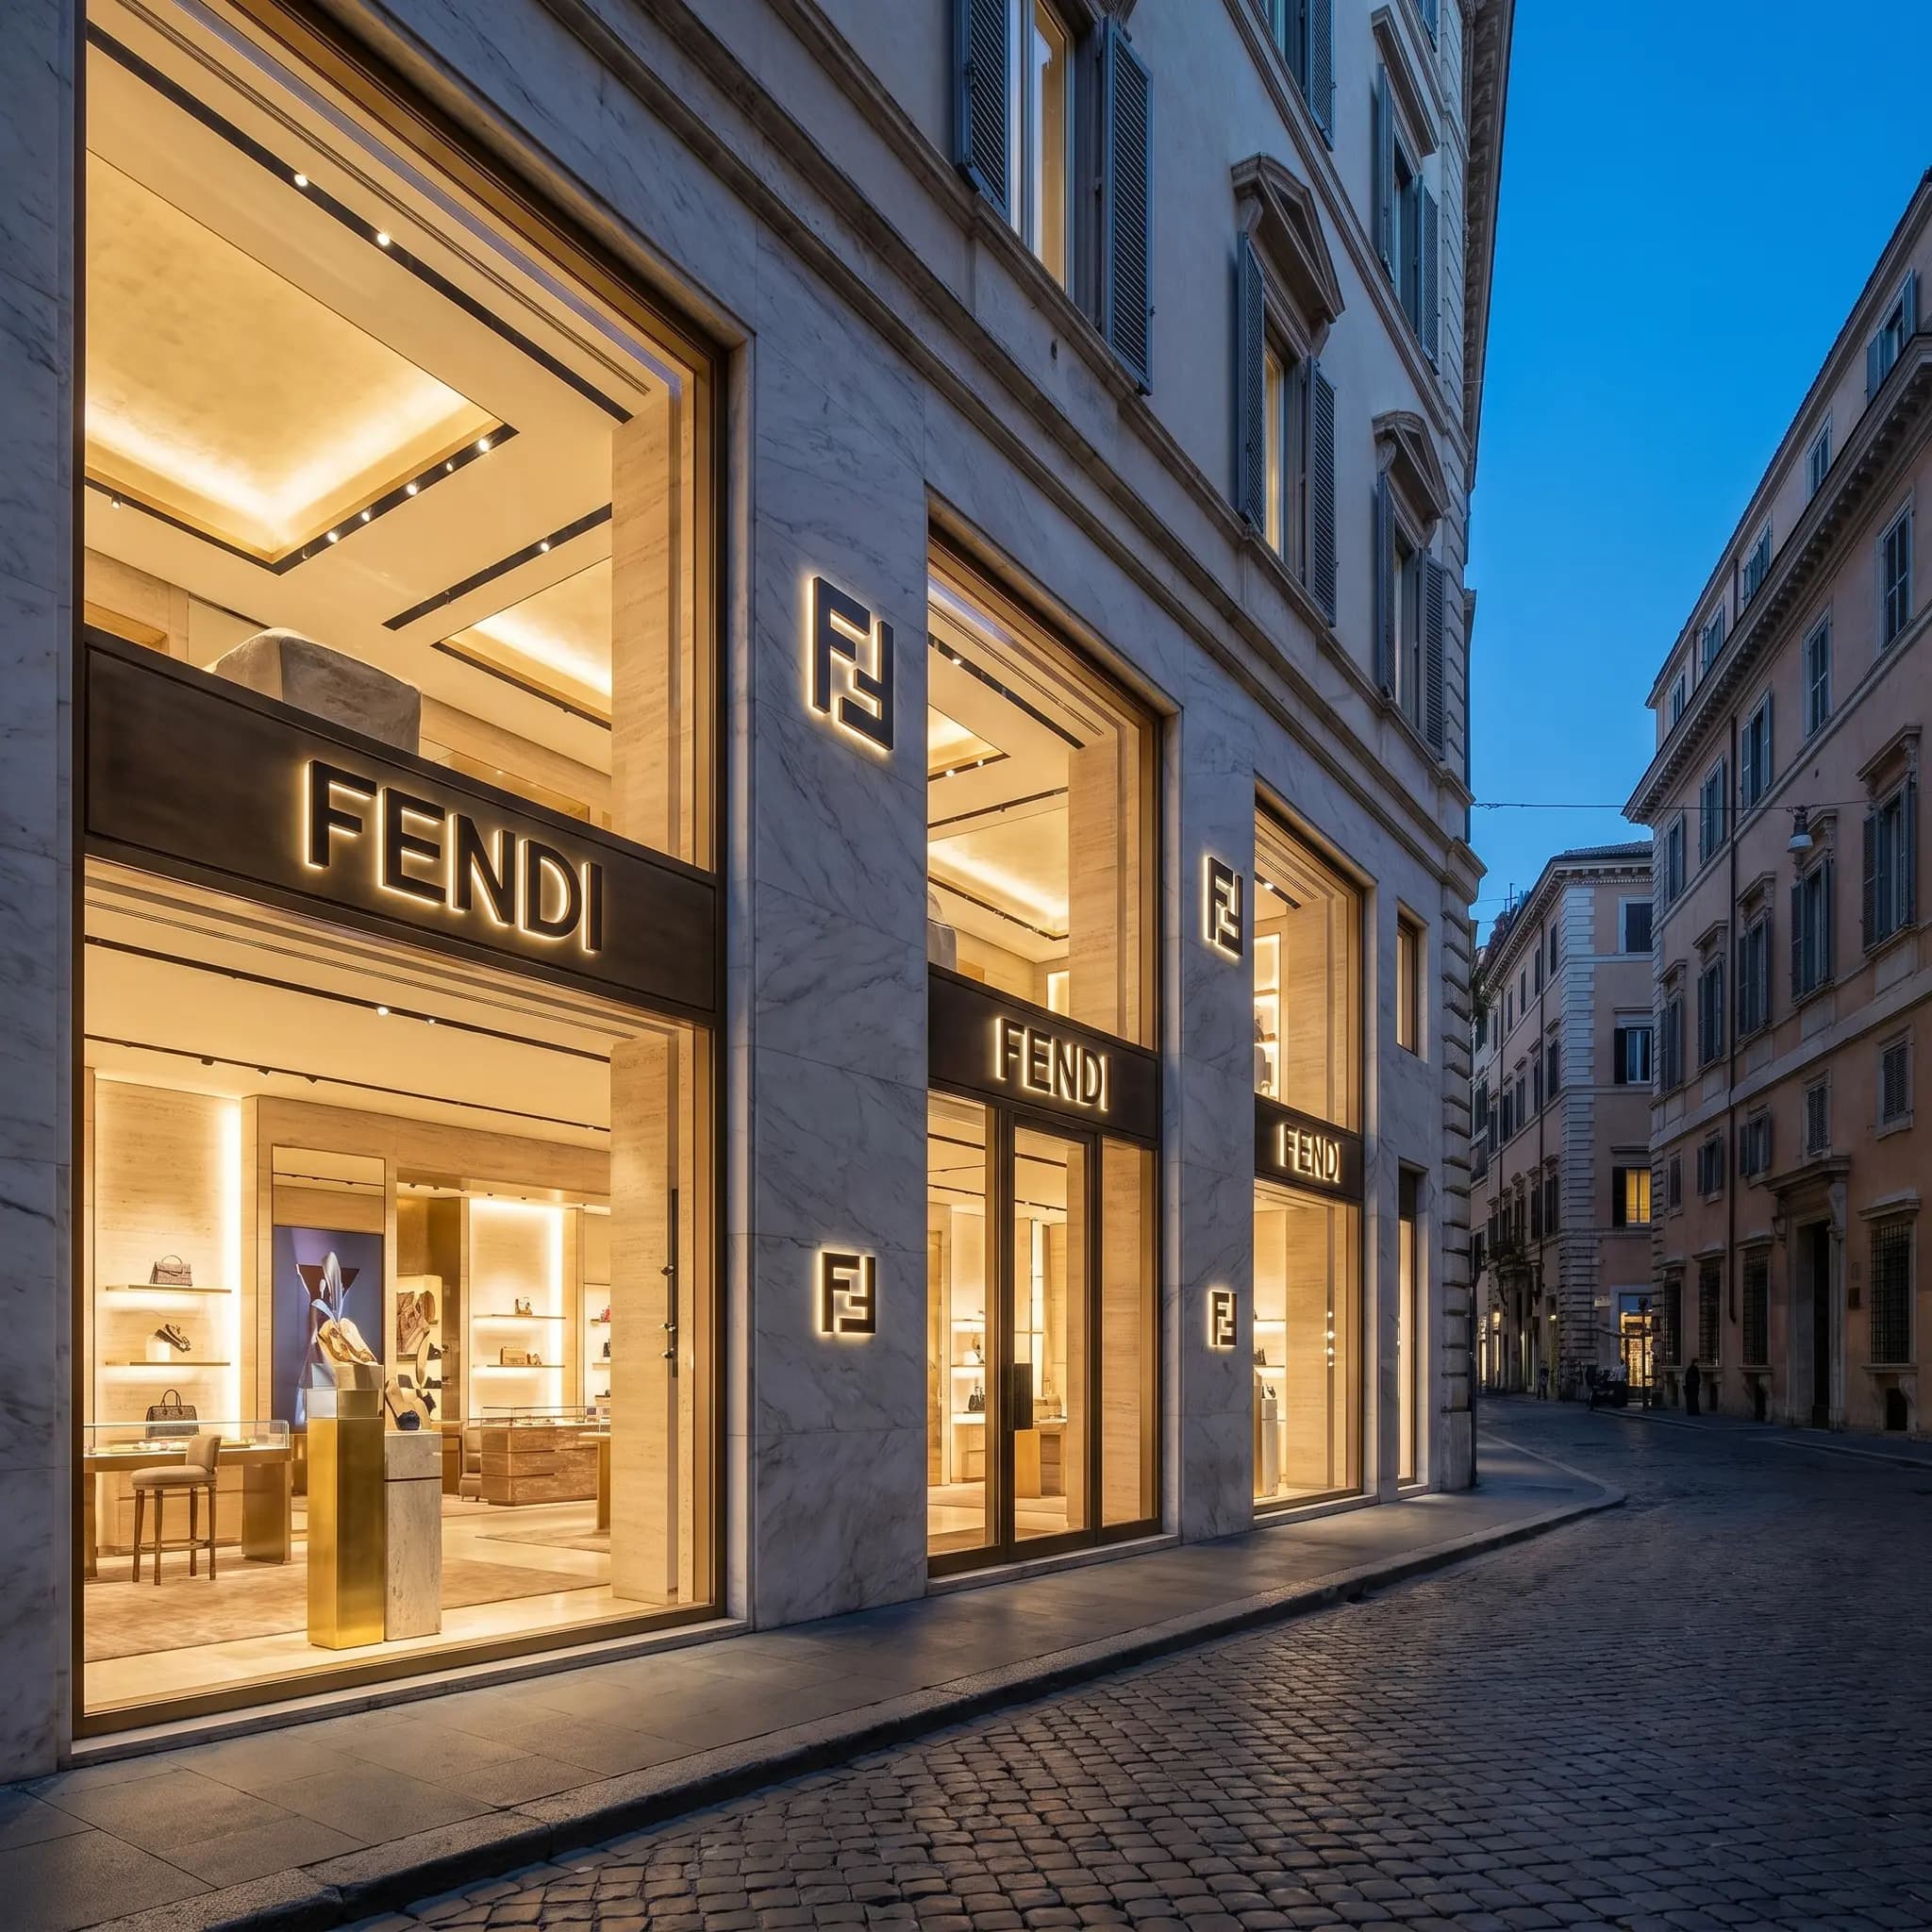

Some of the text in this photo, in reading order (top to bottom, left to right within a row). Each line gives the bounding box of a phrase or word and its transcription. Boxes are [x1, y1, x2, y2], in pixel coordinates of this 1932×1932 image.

[305, 758, 603, 954] FENDI
[998, 1017, 1110, 1110] FENDI
[1280, 1123, 1342, 1183] FENDI
